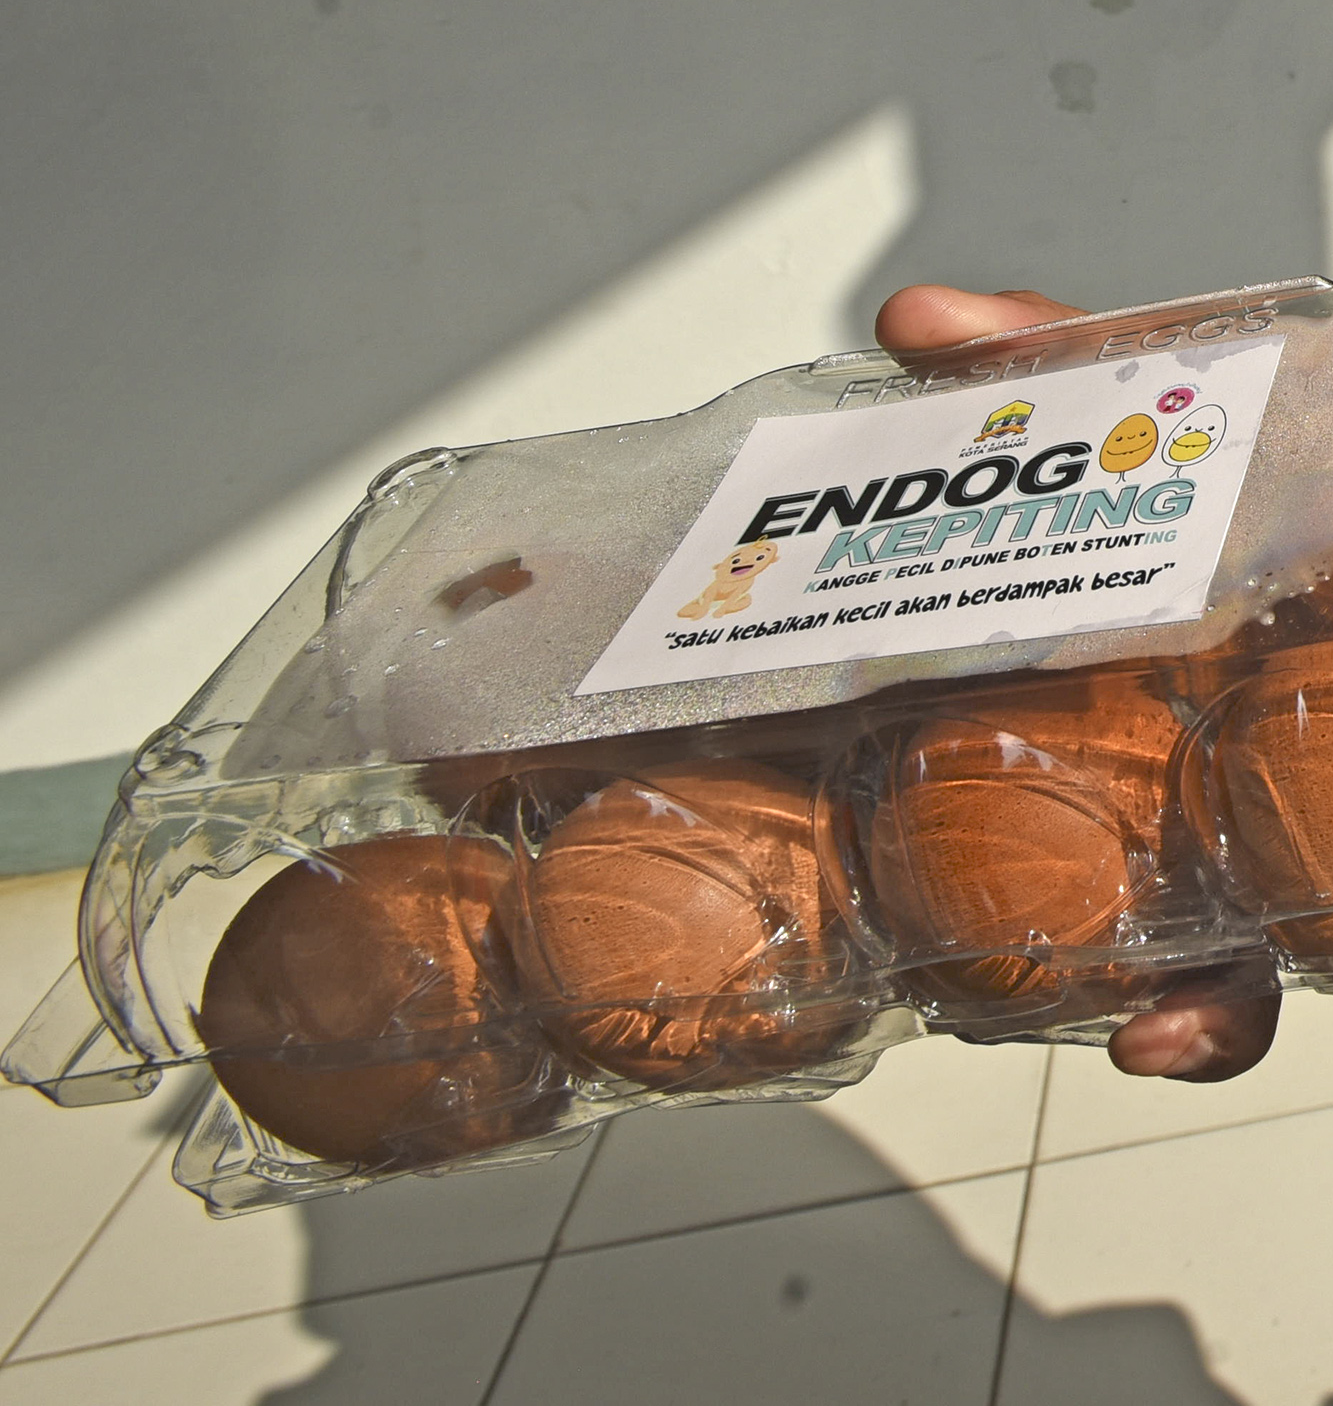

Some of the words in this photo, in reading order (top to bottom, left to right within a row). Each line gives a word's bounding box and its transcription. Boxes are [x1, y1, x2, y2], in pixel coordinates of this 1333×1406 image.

[836, 350, 1048, 409] FRESH
[1096, 307, 1279, 362] EGGS
[959, 449, 984, 458] KOTA
[987, 441, 1028, 453] SERANG
[960, 436, 1029, 452] PEMERINTAH
[735, 441, 1092, 546] ENDOG
[814, 478, 1198, 574] KEPITING
[803, 570, 882, 594] KANGGE
[883, 561, 935, 581] PECIL
[940, 550, 1011, 572] DIPUNE
[1013, 540, 1078, 561] BOTEN
[1081, 530, 1178, 552] STUNTING
[726, 612, 830, 643] kebaikan
[832, 601, 892, 626] kecil
[894, 592, 952, 616] akan
[956, 575, 1085, 608] berdampak
